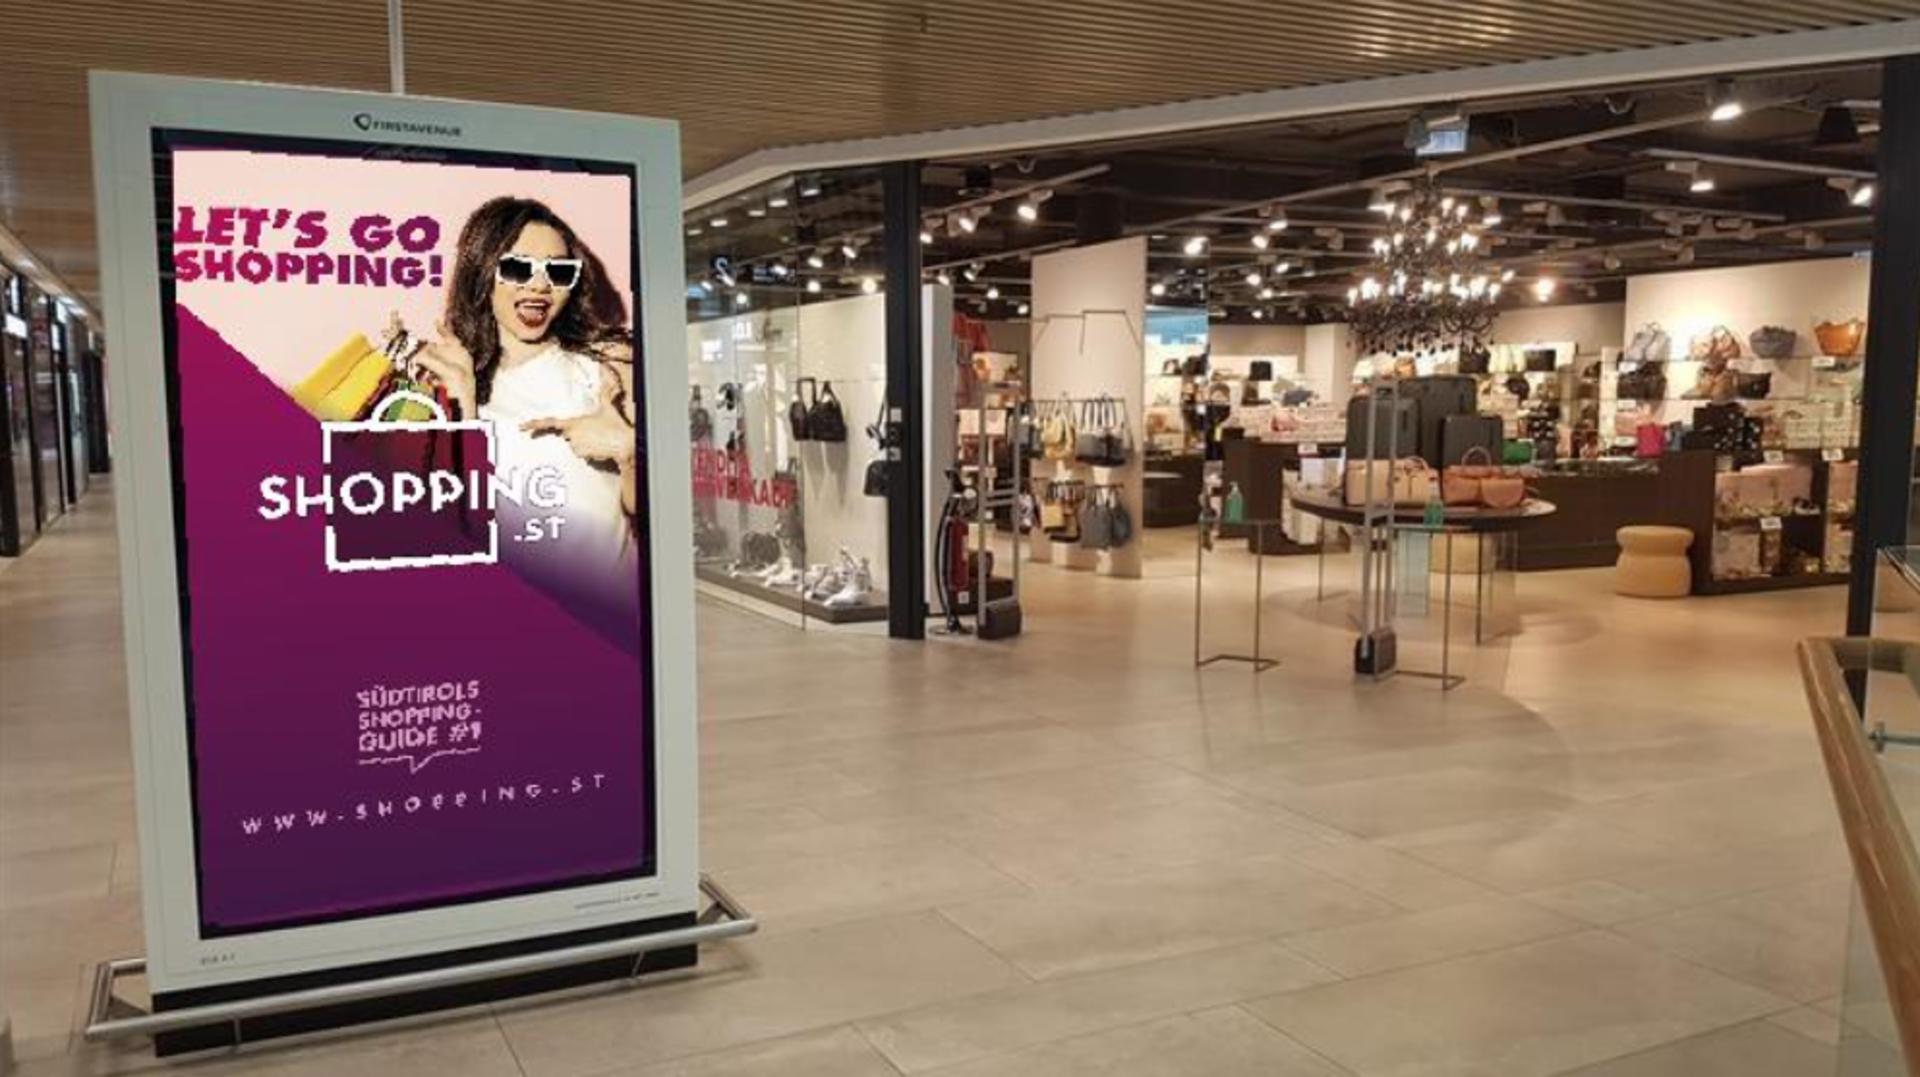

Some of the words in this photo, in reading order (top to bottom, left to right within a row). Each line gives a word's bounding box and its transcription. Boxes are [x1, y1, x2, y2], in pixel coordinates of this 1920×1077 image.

[174, 206, 328, 248] LET'S
[350, 214, 440, 253] GO
[174, 249, 442, 288] SHOPPING!
[258, 465, 568, 519] SHOPPING
[357, 680, 480, 709] SÜDTIROLS
[358, 726, 438, 752] GUIDE
[447, 720, 482, 742] #1
